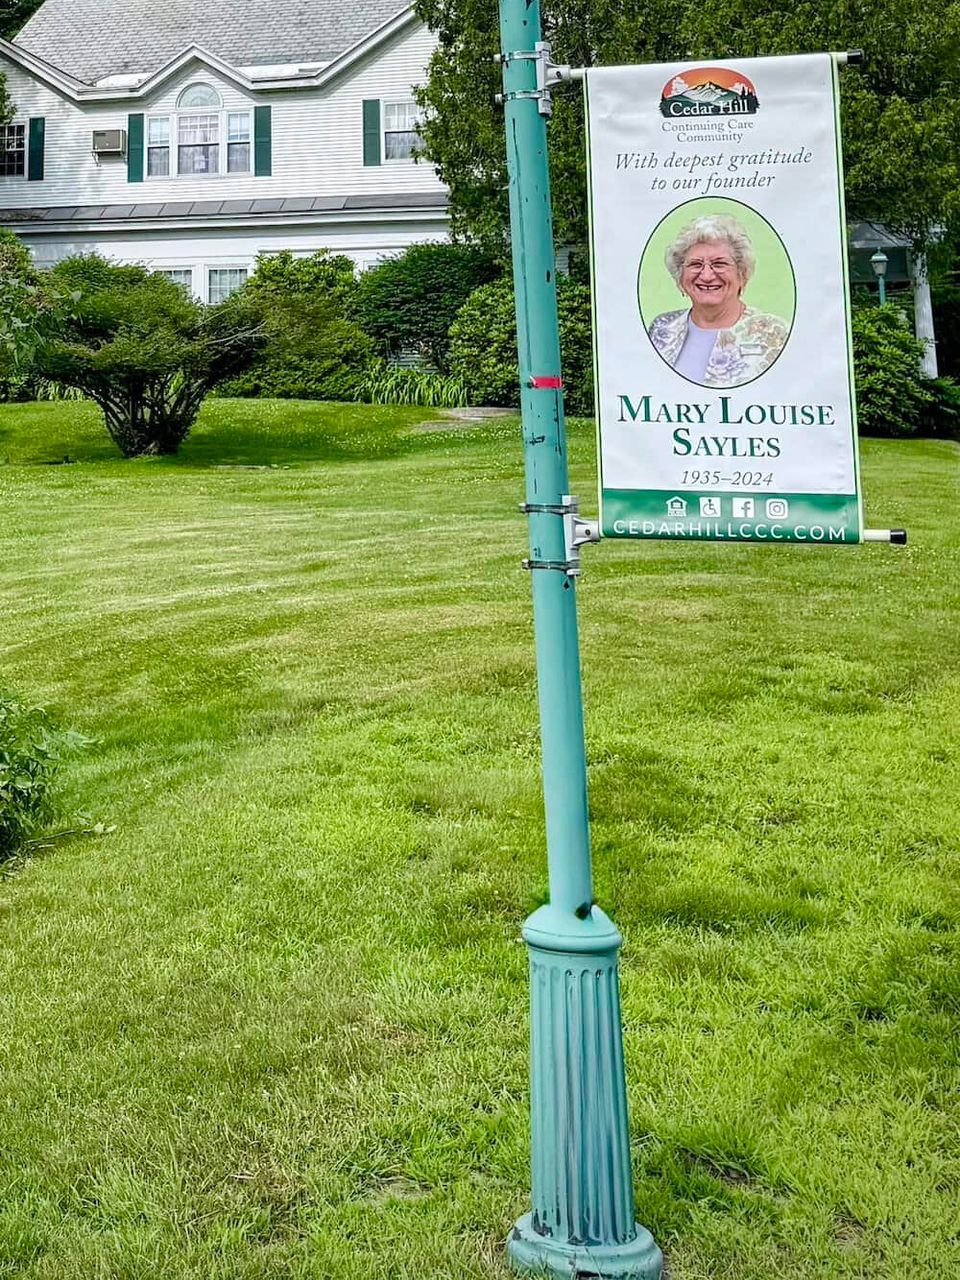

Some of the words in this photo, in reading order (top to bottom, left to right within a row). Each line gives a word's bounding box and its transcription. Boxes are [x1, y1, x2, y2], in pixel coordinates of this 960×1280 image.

[669, 102, 714, 116] Cedar
[719, 99, 749, 115] Hill
[662, 120, 725, 133] Continuing
[727, 119, 754, 130] Care
[677, 131, 743, 143] Community
[616, 152, 658, 169] With
[663, 151, 723, 172] deepest
[727, 147, 813, 171] gratitude
[651, 176, 667, 190] to
[672, 177, 702, 190] our
[701, 172, 776, 194] founder
[617, 394, 711, 423] MARY
[718, 396, 835, 426] LOUISE
[672, 427, 781, 458] SAYLES
[613, 519, 846, 541] CEDARHILLCCC.COM
